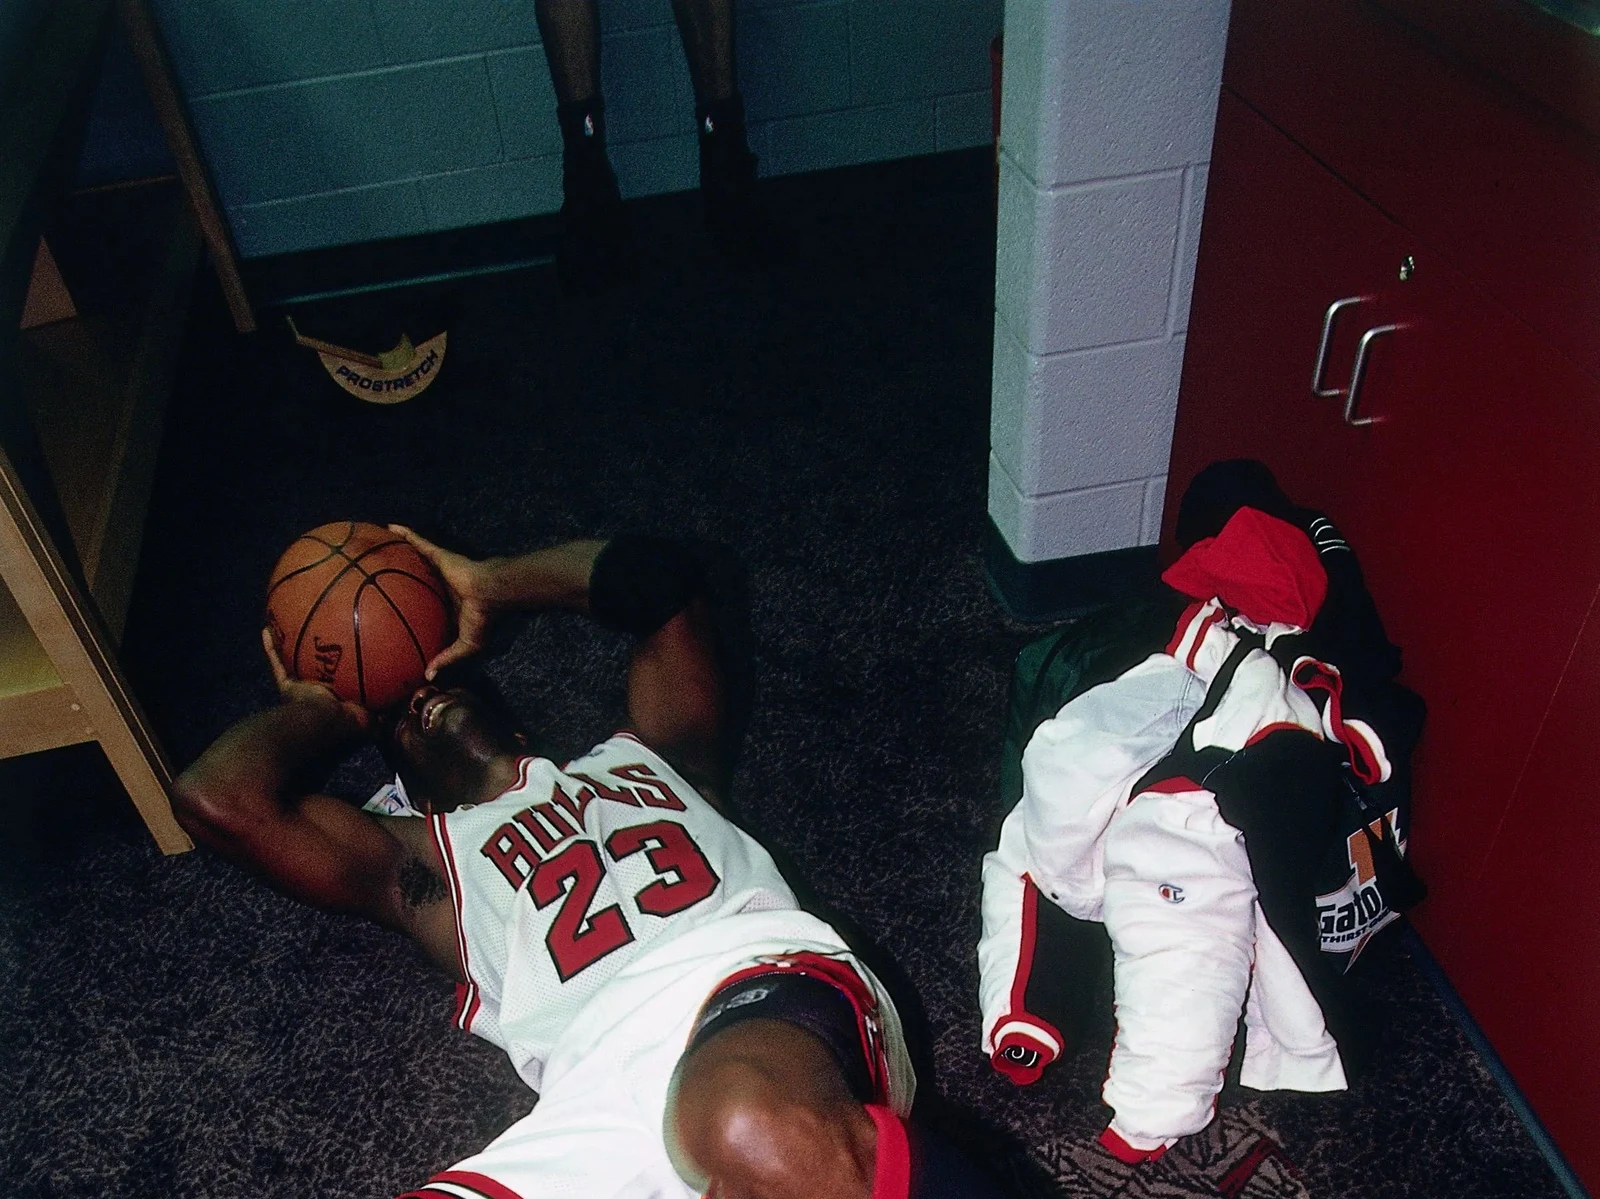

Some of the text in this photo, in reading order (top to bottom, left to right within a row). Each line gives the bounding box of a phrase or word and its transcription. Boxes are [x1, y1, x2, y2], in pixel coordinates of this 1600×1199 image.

[336, 349, 438, 391] PROSTRETCH
[527, 819, 721, 983] 23
[1316, 886, 1384, 933] Gato
[1321, 925, 1368, 943] THIRST
